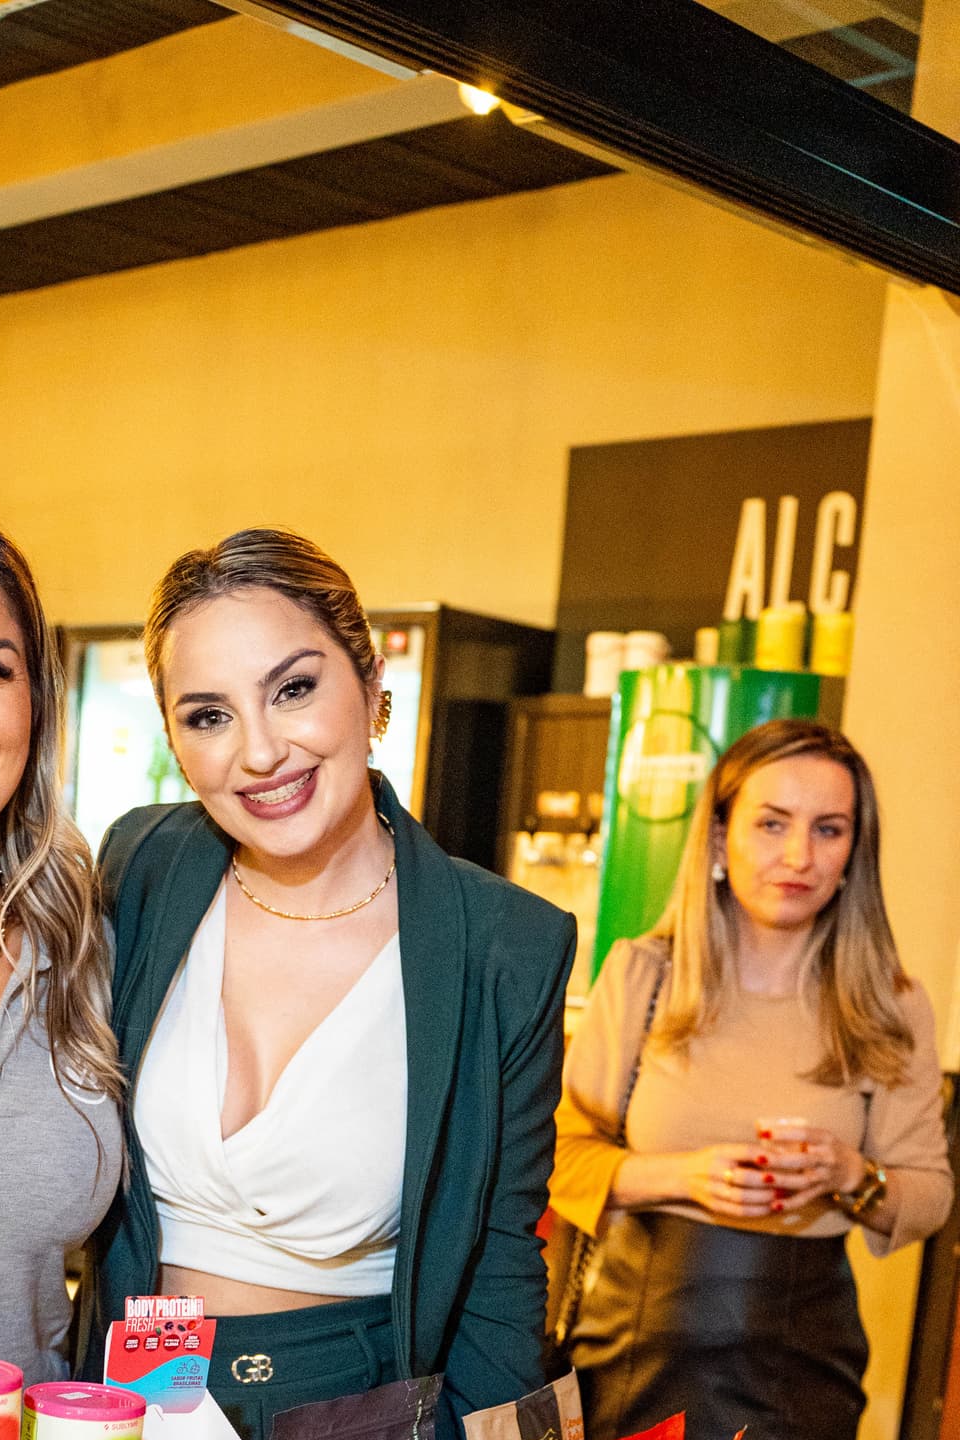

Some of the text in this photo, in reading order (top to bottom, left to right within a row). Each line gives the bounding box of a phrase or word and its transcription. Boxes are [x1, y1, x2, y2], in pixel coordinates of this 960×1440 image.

[723, 490, 857, 623] ALC
[127, 1298, 197, 1318] BODY PROTEIN
[125, 1318, 155, 1332] FRESH
